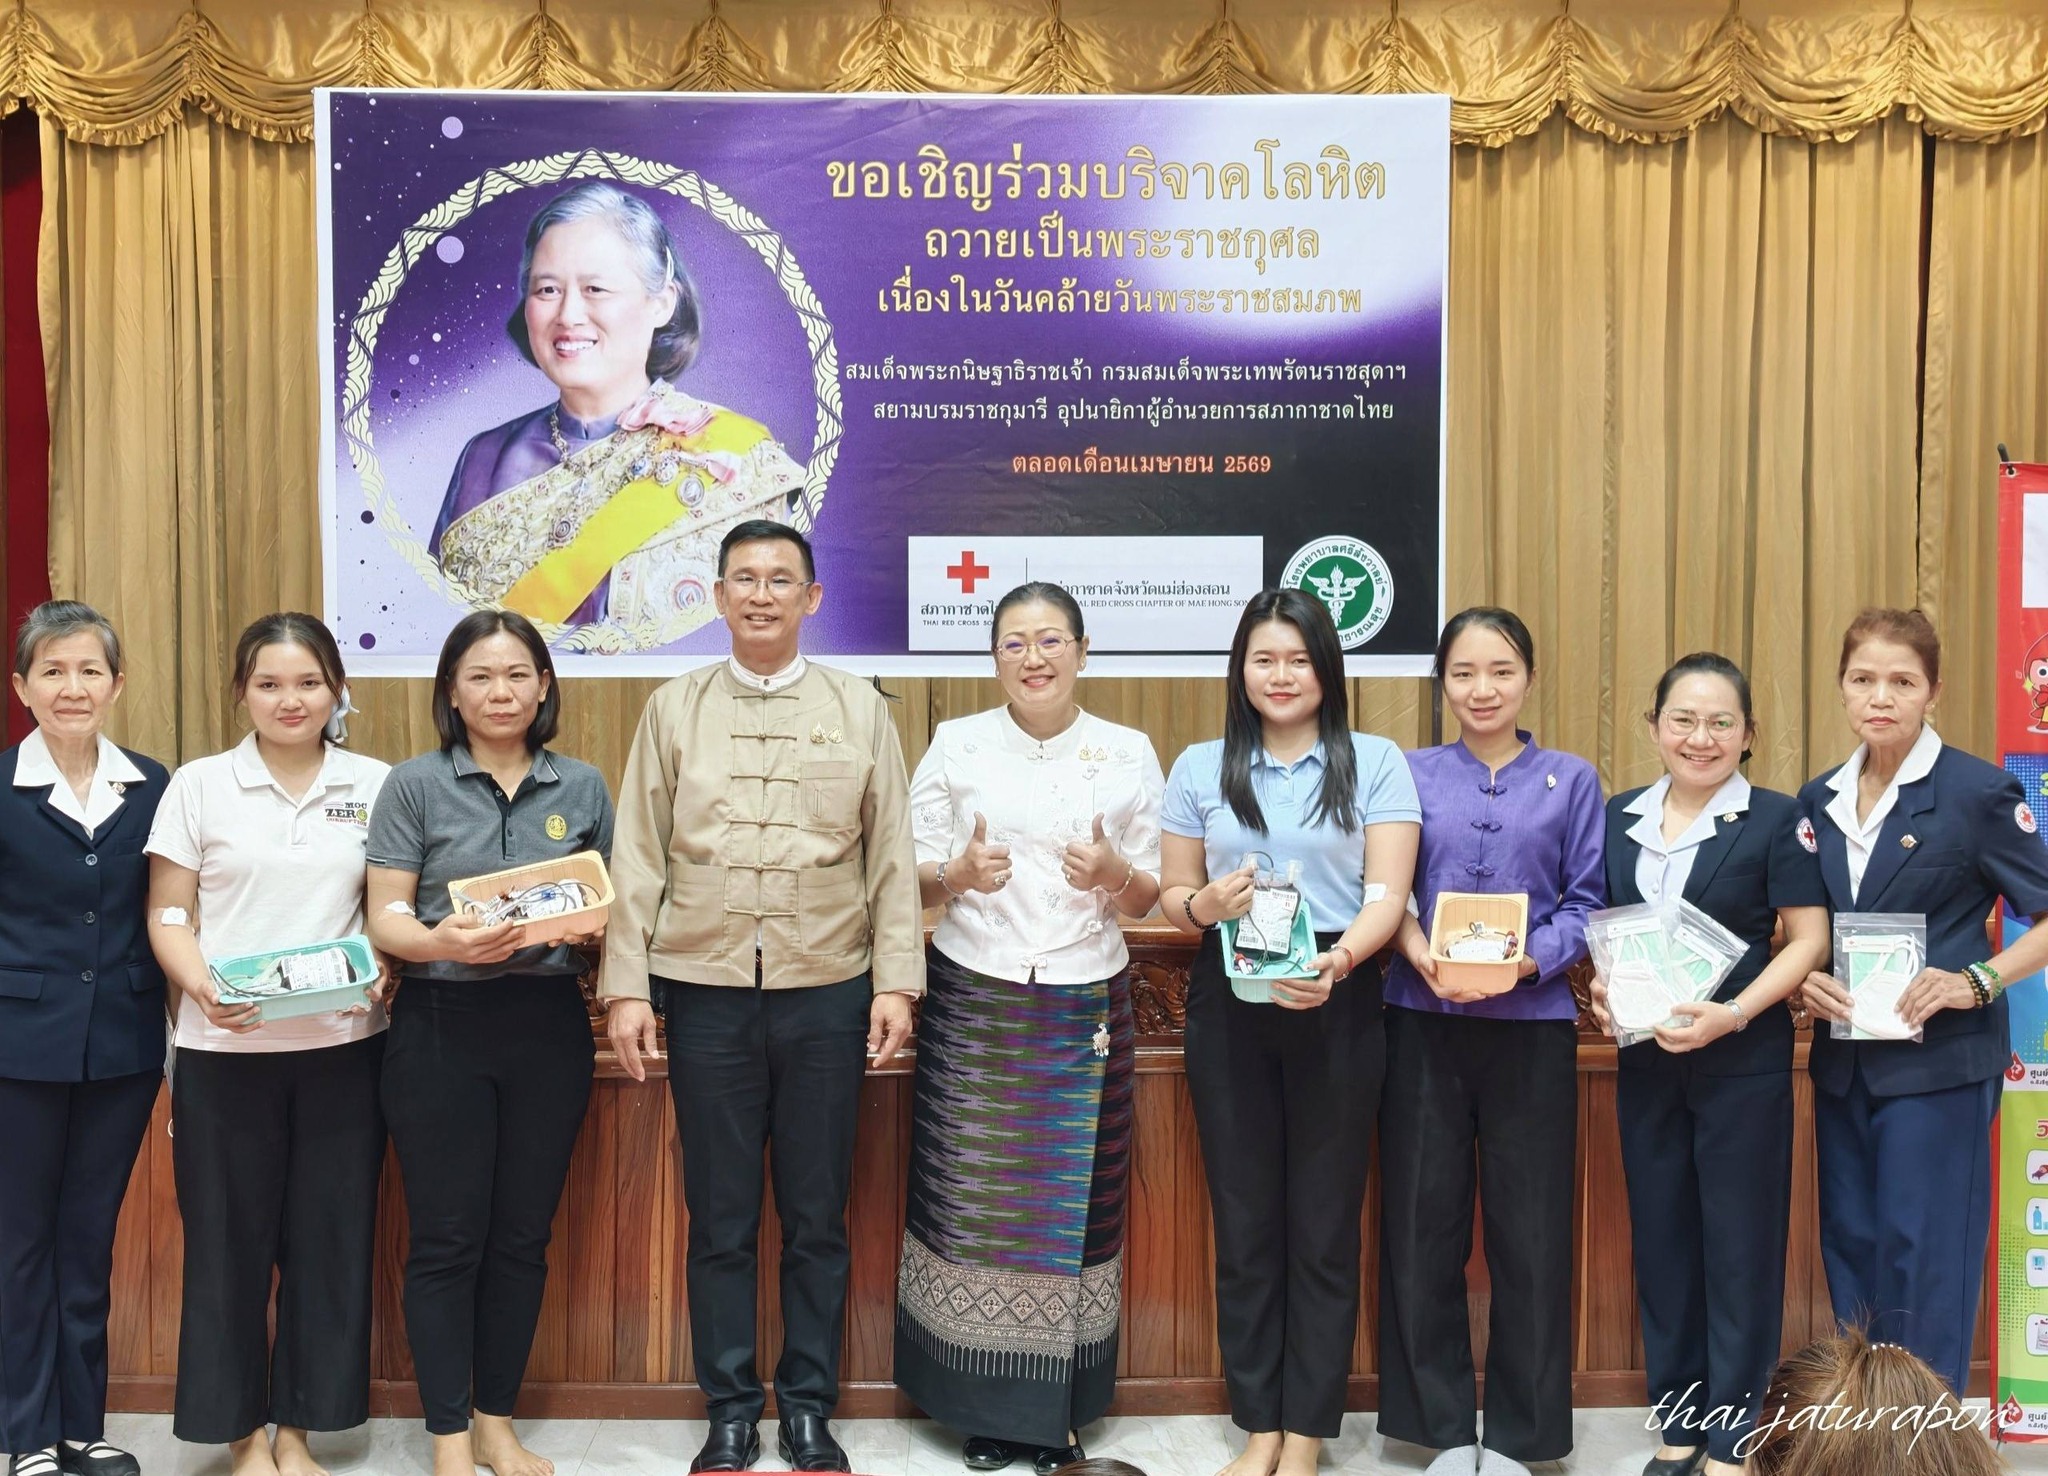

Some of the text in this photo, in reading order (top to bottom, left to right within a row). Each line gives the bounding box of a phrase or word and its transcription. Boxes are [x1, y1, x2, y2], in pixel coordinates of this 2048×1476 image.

[826, 138, 1387, 212] ขอเชิญร่วมบริจาคโลหิต
[925, 210, 1320, 276] ถวายเป็นพระราชกุศล
[878, 265, 1362, 313] เนื่องในวันคล้ายวันพระราชสมภพ
[845, 355, 1407, 388] สมเด็จพระกนิษฐาธิราชเจ้า กรมสมเด็จพระเทพรัตนราชสุดาฯ
[873, 395, 1394, 428] สยามบรมราชกุมารี อุปนายิกาผู้อำนวยการสภากาชาดไทย
[1012, 446, 1272, 474] ตลอดเดือนเมษายน 2569
[1060, 580, 1231, 596] ่ากาชาดจังหวัดแม่ฮ่องสอน
[1091, 600, 1107, 608] RED
[1108, 600, 1135, 608] CROSS
[1135, 600, 1175, 608] CHAPTER
[1175, 600, 1186, 608] OF
[1187, 600, 1207, 608] MAE
[1208, 600, 1233, 608] HONG
[920, 599, 995, 615] สภากาชาดไ
